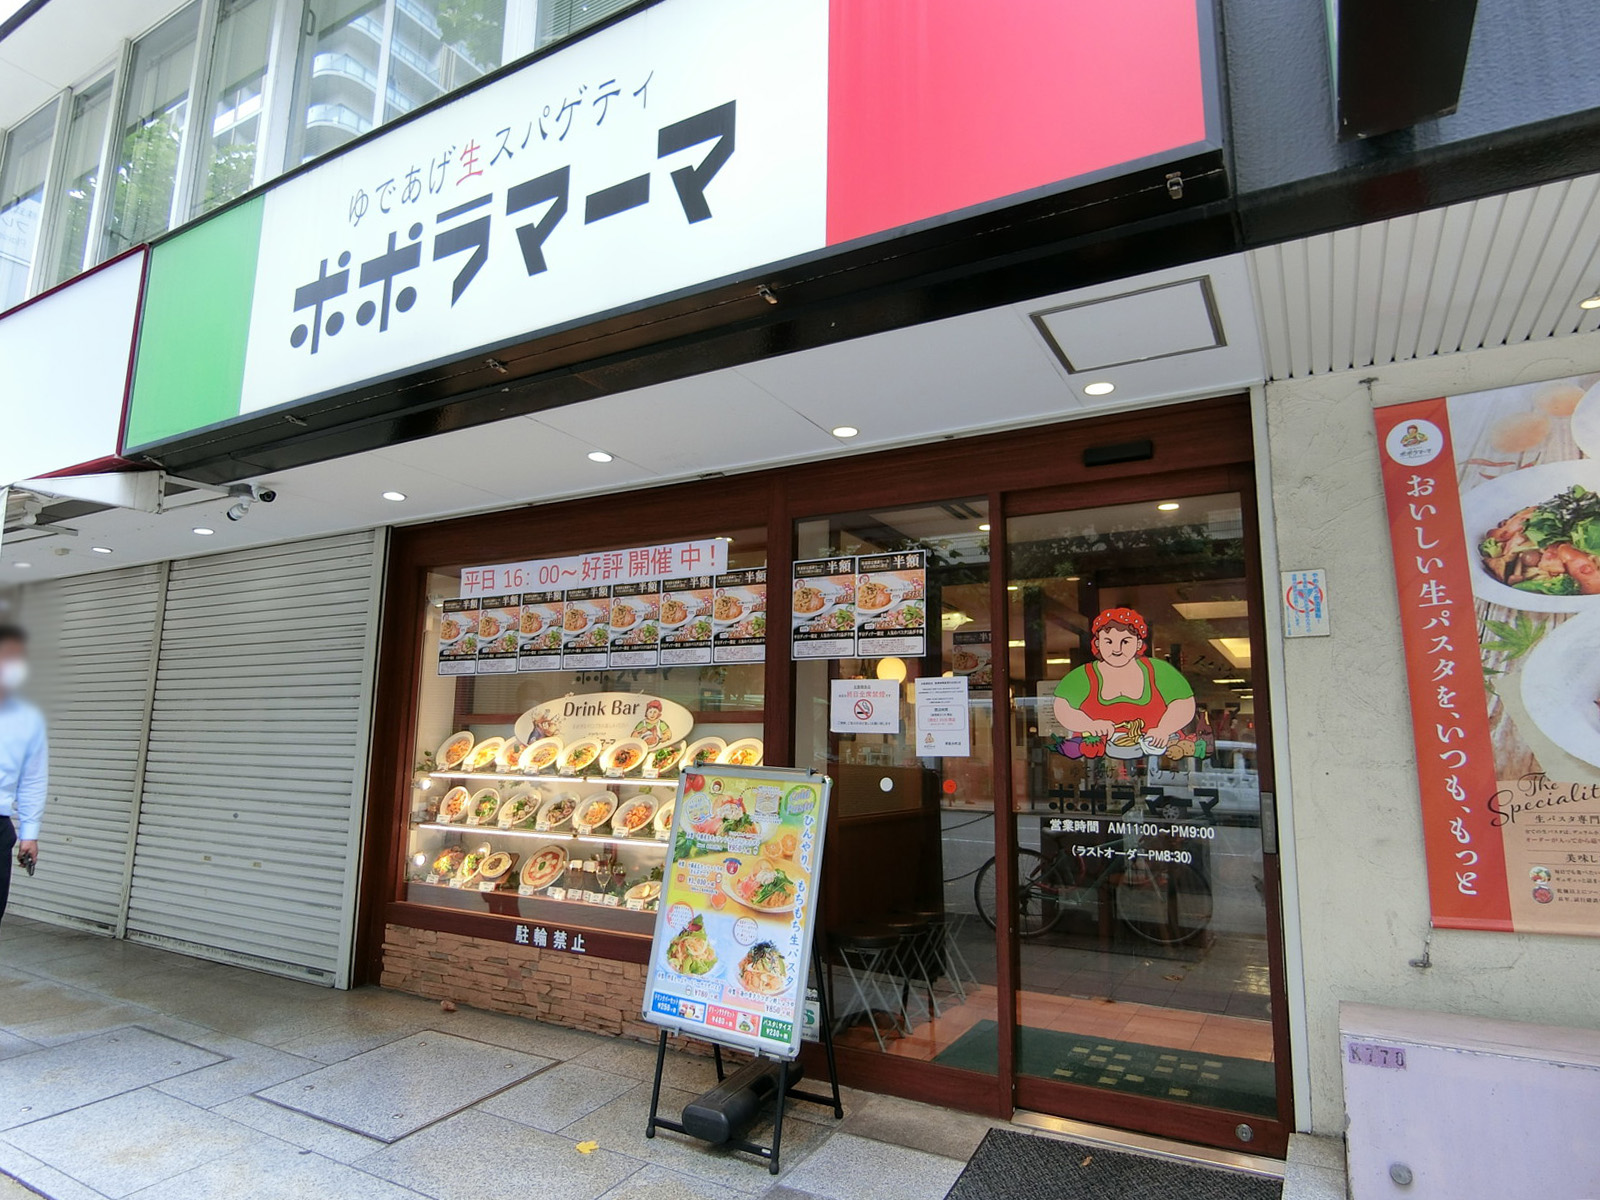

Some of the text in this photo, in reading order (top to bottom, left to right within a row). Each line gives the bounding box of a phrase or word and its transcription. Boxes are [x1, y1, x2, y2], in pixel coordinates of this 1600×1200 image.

[349, 70, 654, 227] ゆであげ生スパゲティ
[290, 100, 737, 354] ポポラマーマ
[826, 559, 852, 574] 半額
[893, 554, 920, 569] 半額
[690, 576, 711, 588] 半額
[1407, 474, 1477, 896] おいしい生パスタを、いつも、もっと
[563, 700, 640, 717] Drink Bar
[1517, 771, 1560, 797] The
[1050, 818, 1100, 834] 営業時間
[515, 924, 586, 953] 駐輪禁止
[785, 880, 806, 987] もちもち生パスタ
